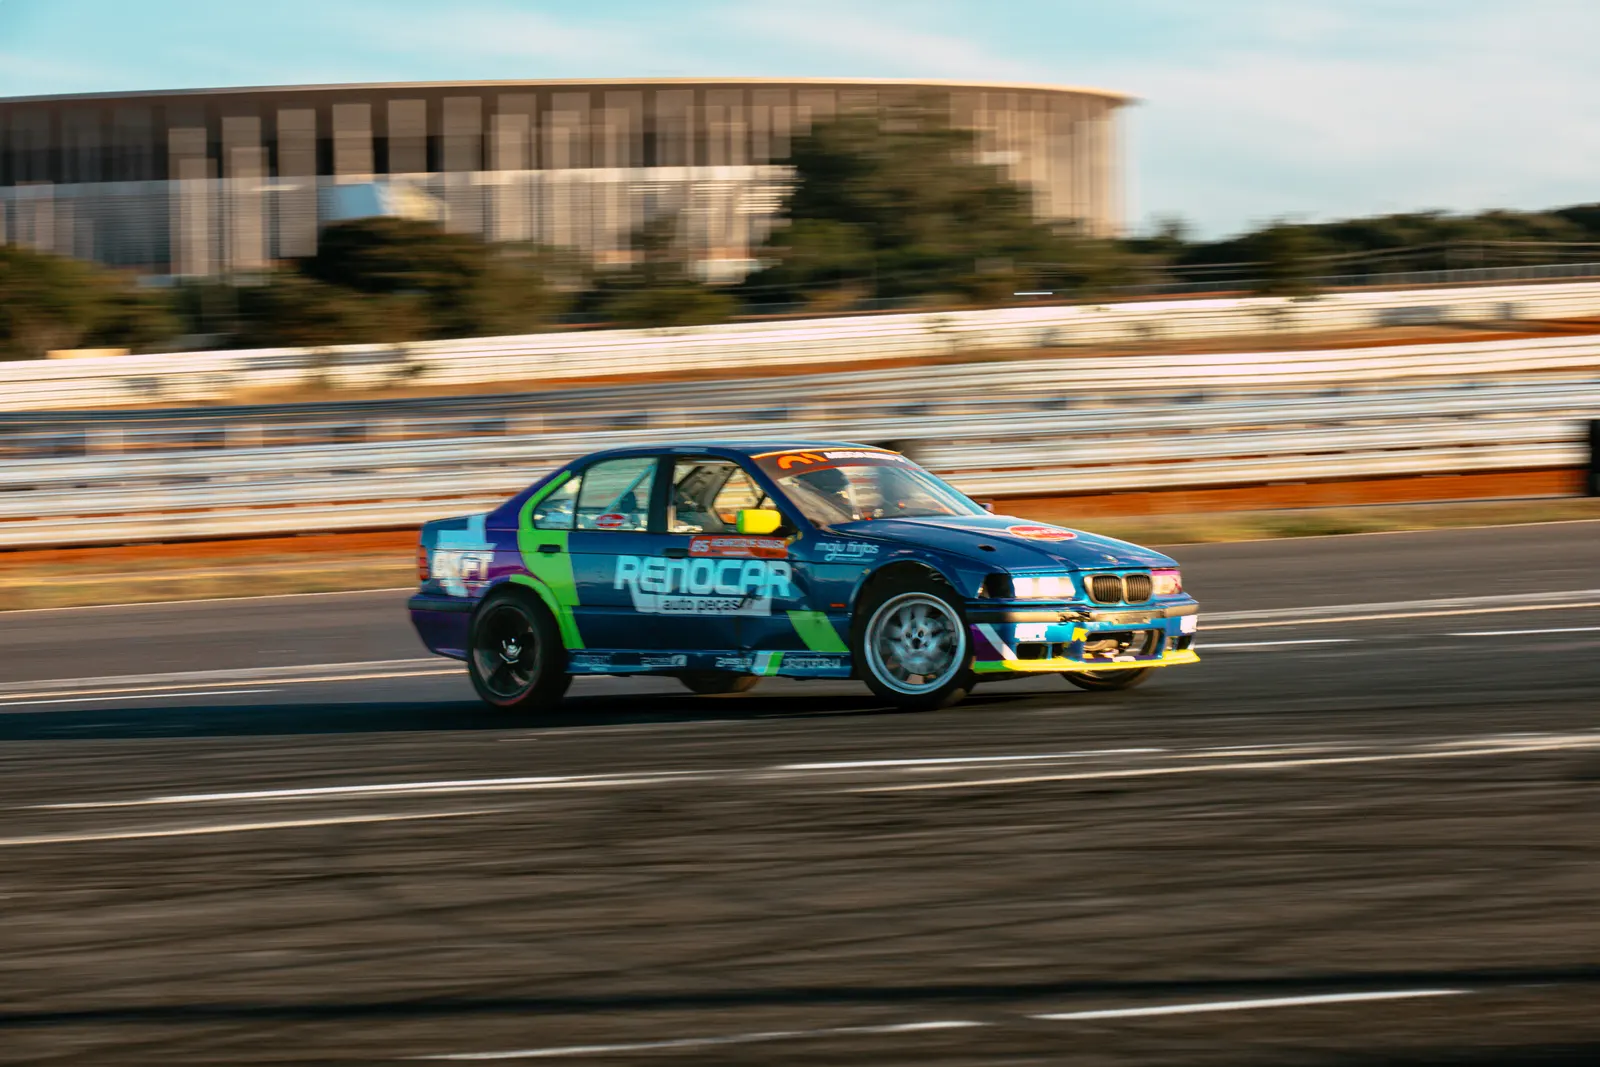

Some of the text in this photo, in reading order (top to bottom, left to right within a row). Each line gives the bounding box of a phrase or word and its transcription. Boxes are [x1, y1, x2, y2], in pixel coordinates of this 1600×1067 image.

[613, 555, 792, 597] RENOCAR
[663, 599, 740, 613] auto peças
